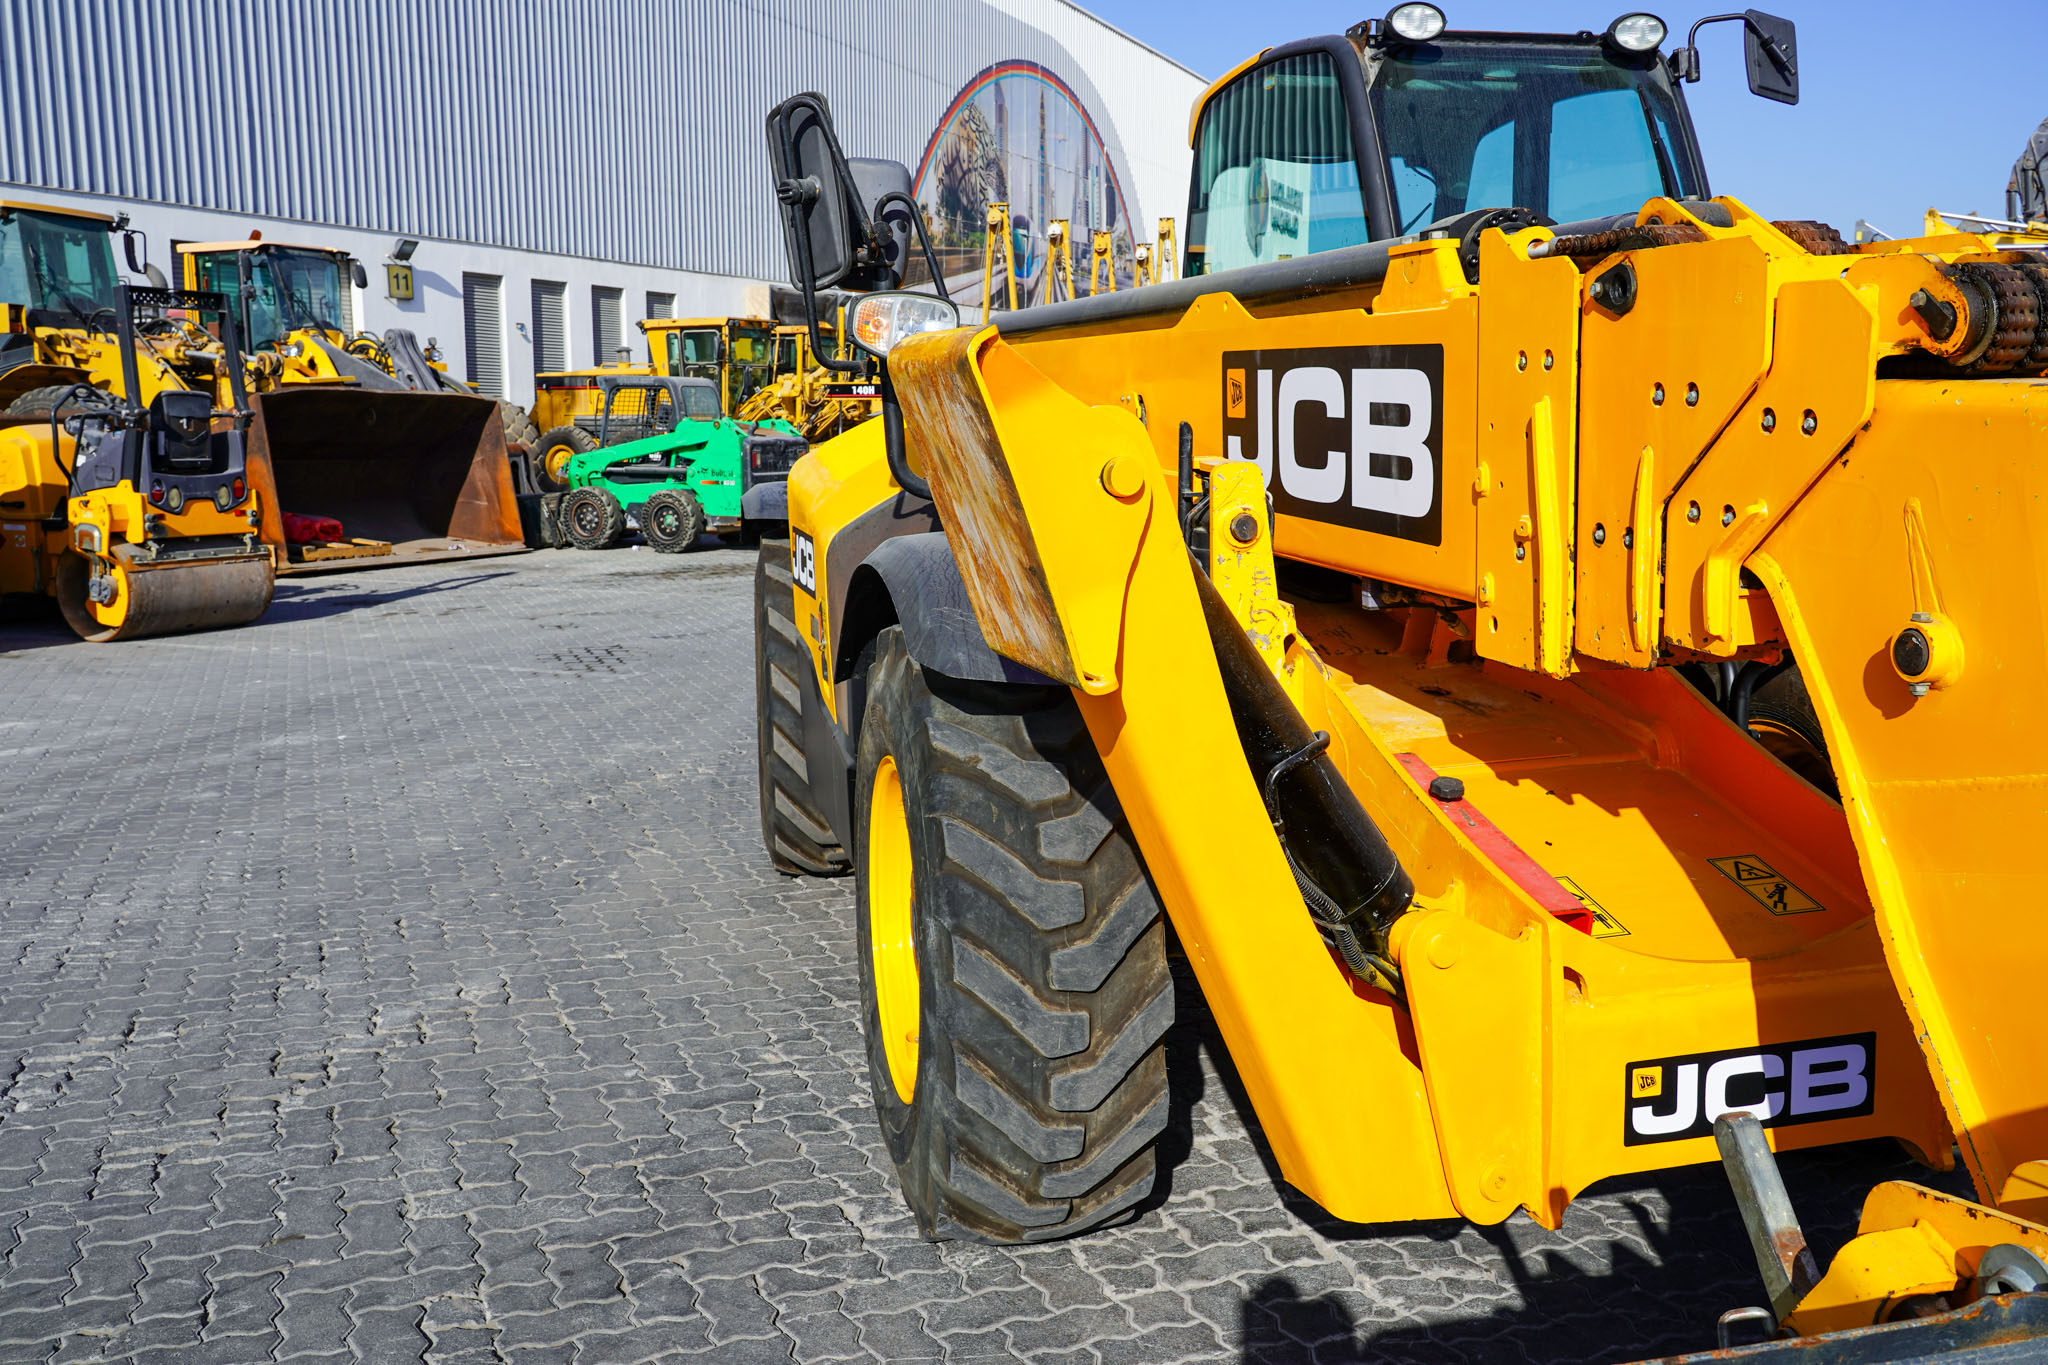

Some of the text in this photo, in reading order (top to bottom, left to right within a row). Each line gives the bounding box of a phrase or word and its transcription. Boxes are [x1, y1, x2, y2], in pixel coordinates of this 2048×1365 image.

[393, 273, 409, 291] 11
[851, 385, 875, 395] 140H
[1231, 381, 1242, 405] JCB
[1227, 366, 1434, 518] JCB
[793, 534, 816, 592] JCB
[1631, 1044, 1868, 1135] JCB
[1639, 1076, 1656, 1089] JCB
